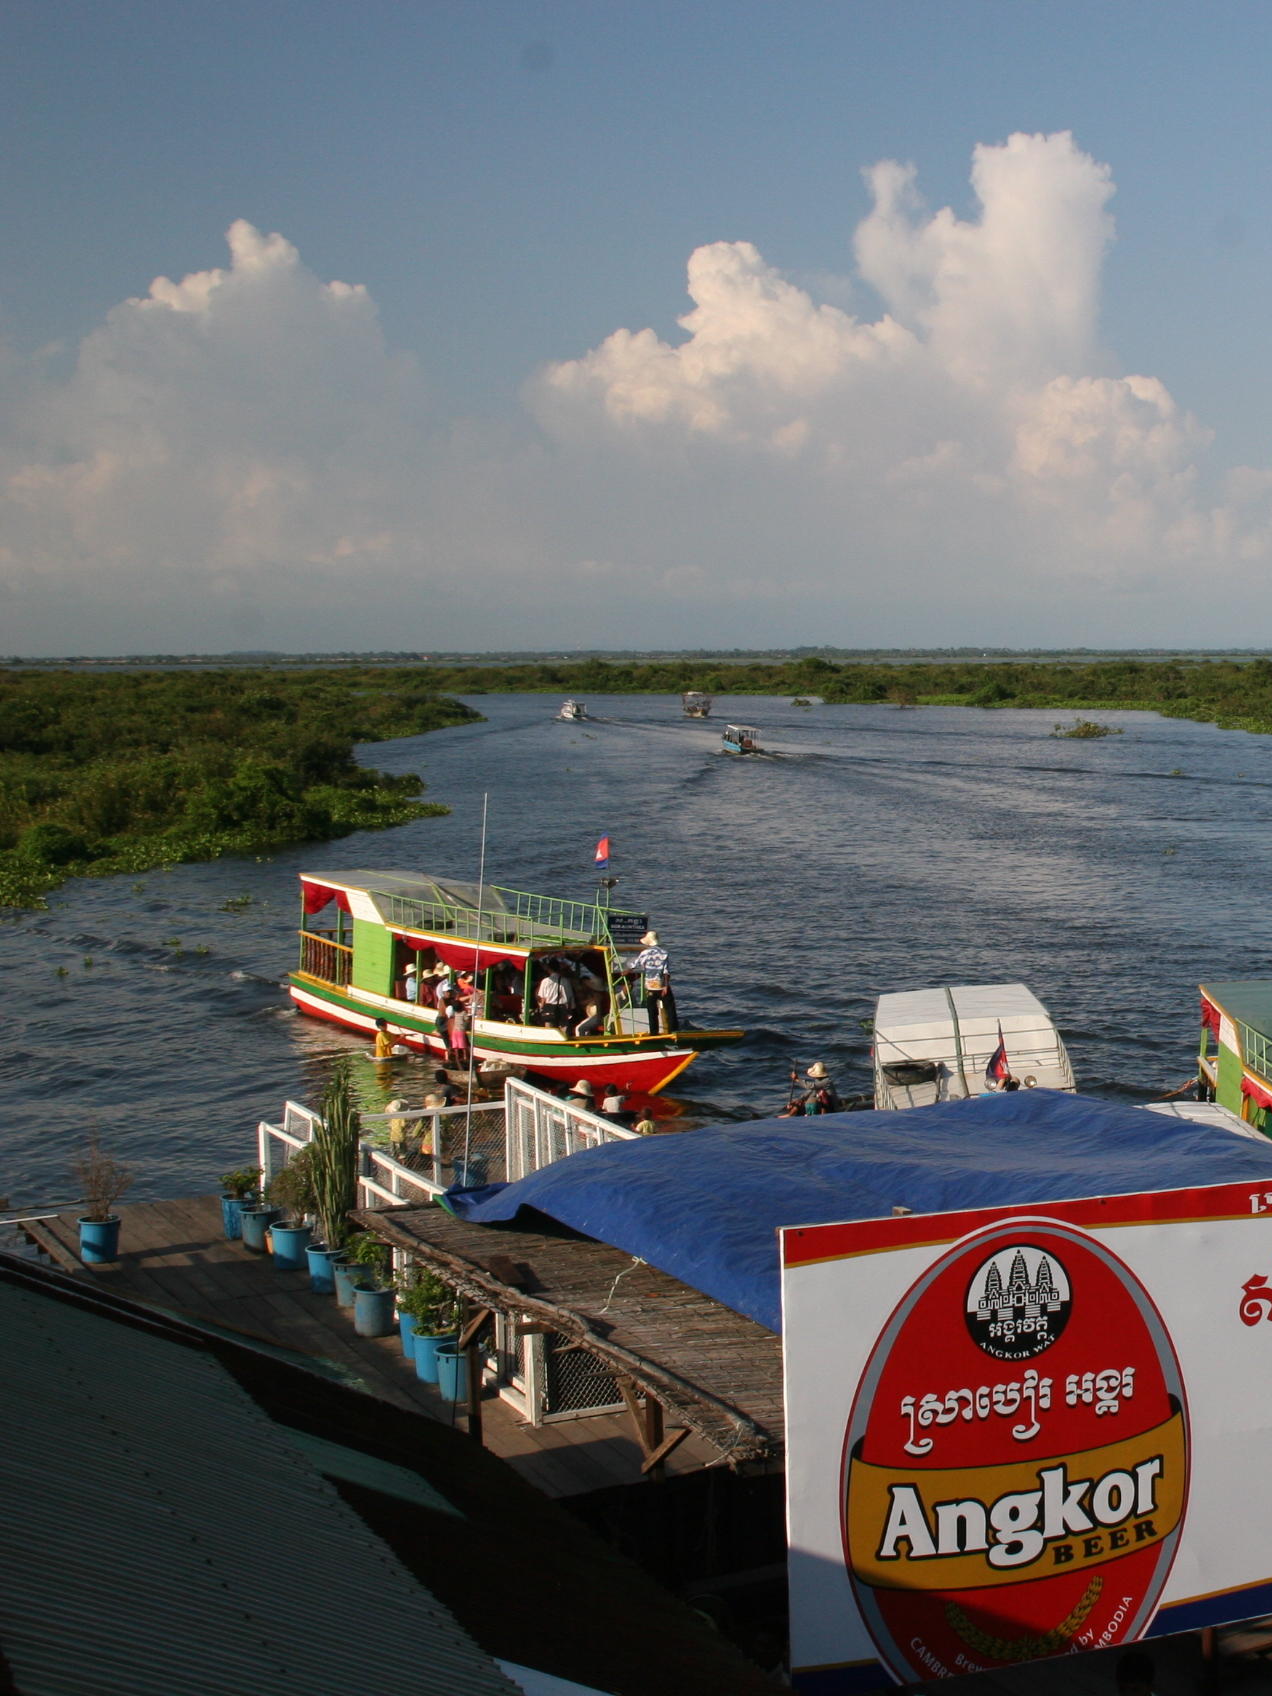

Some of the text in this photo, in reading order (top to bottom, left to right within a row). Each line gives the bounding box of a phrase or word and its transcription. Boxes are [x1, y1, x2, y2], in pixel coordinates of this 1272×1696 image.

[979, 1333, 1056, 1359] ANGKOR WAT
[1065, 1366, 1136, 1416] អង្គរ
[879, 1456, 1162, 1567] Angkor
[1052, 1519, 1158, 1566] BEER
[1078, 1628, 1094, 1646] by
